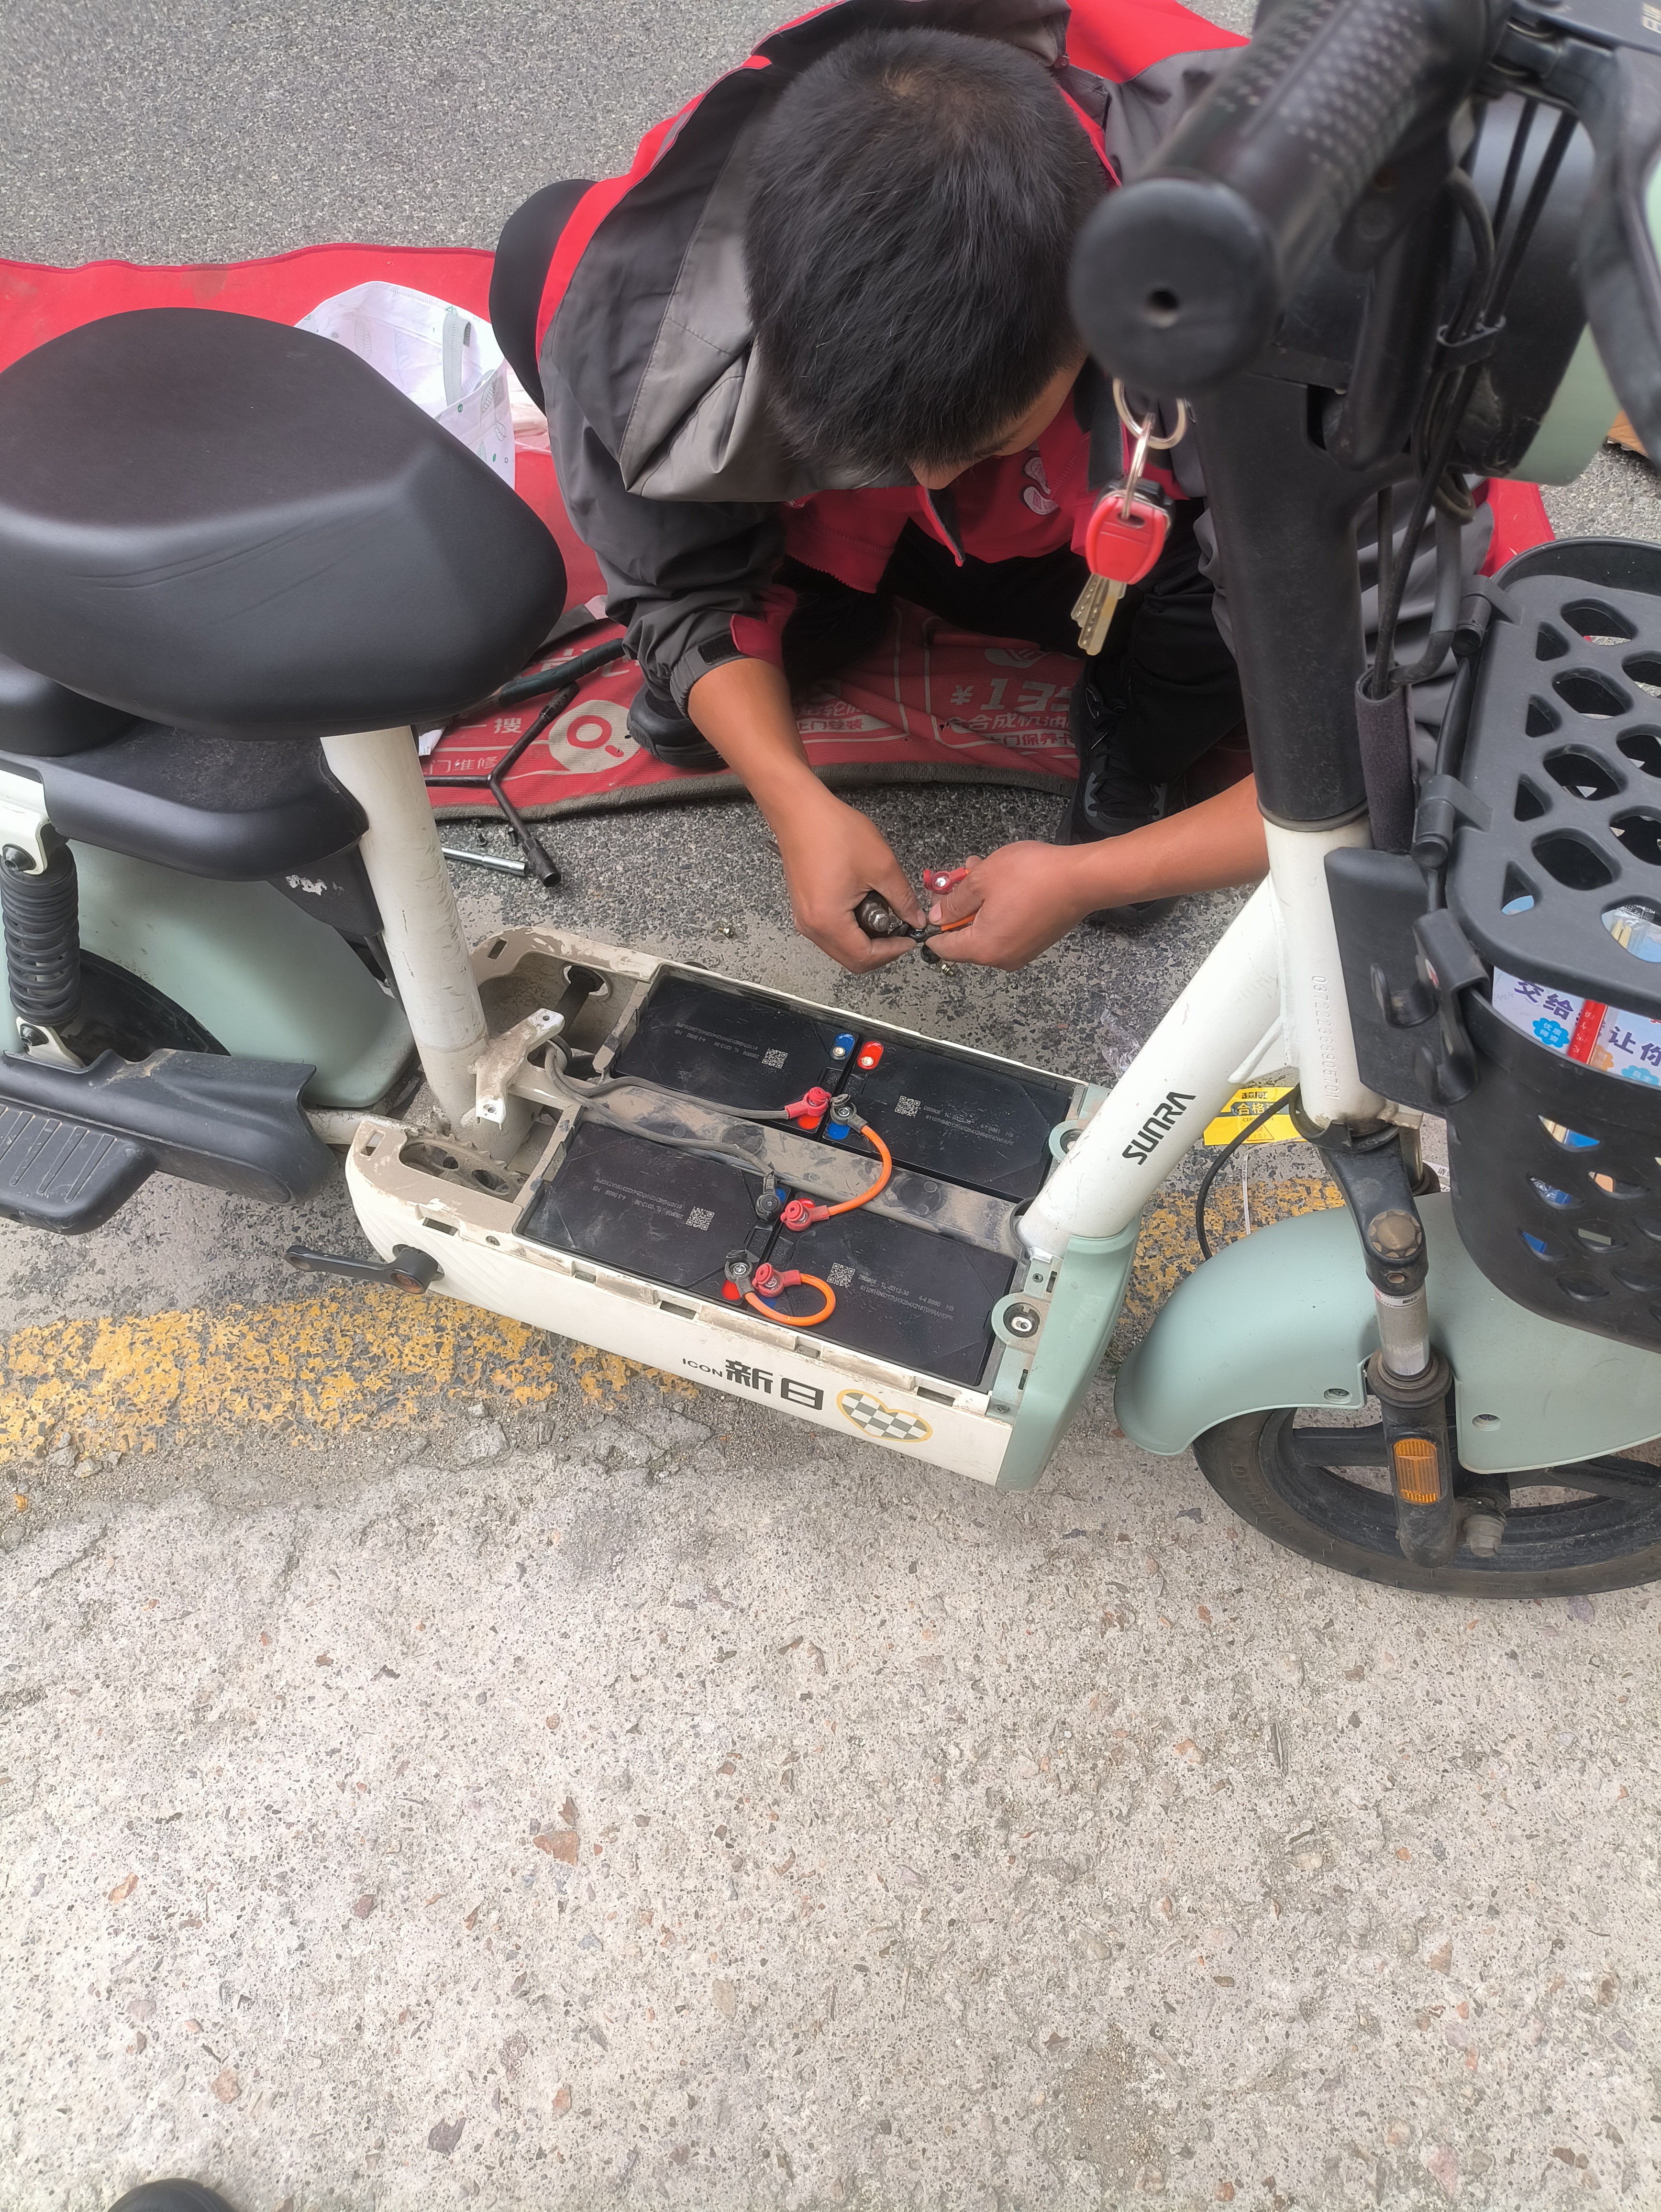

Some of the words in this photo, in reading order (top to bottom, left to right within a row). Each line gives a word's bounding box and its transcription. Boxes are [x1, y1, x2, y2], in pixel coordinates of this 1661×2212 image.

[947, 712, 1070, 730] 合成机油
[422, 755, 498, 775] 门维修
[1311, 975, 1341, 1101] 037222368905701
[1241, 1091, 1268, 1099] 超威
[1122, 1092, 1196, 1165] SUNRA
[683, 1358, 723, 1377] ICON
[725, 1359, 824, 1410] 新日
